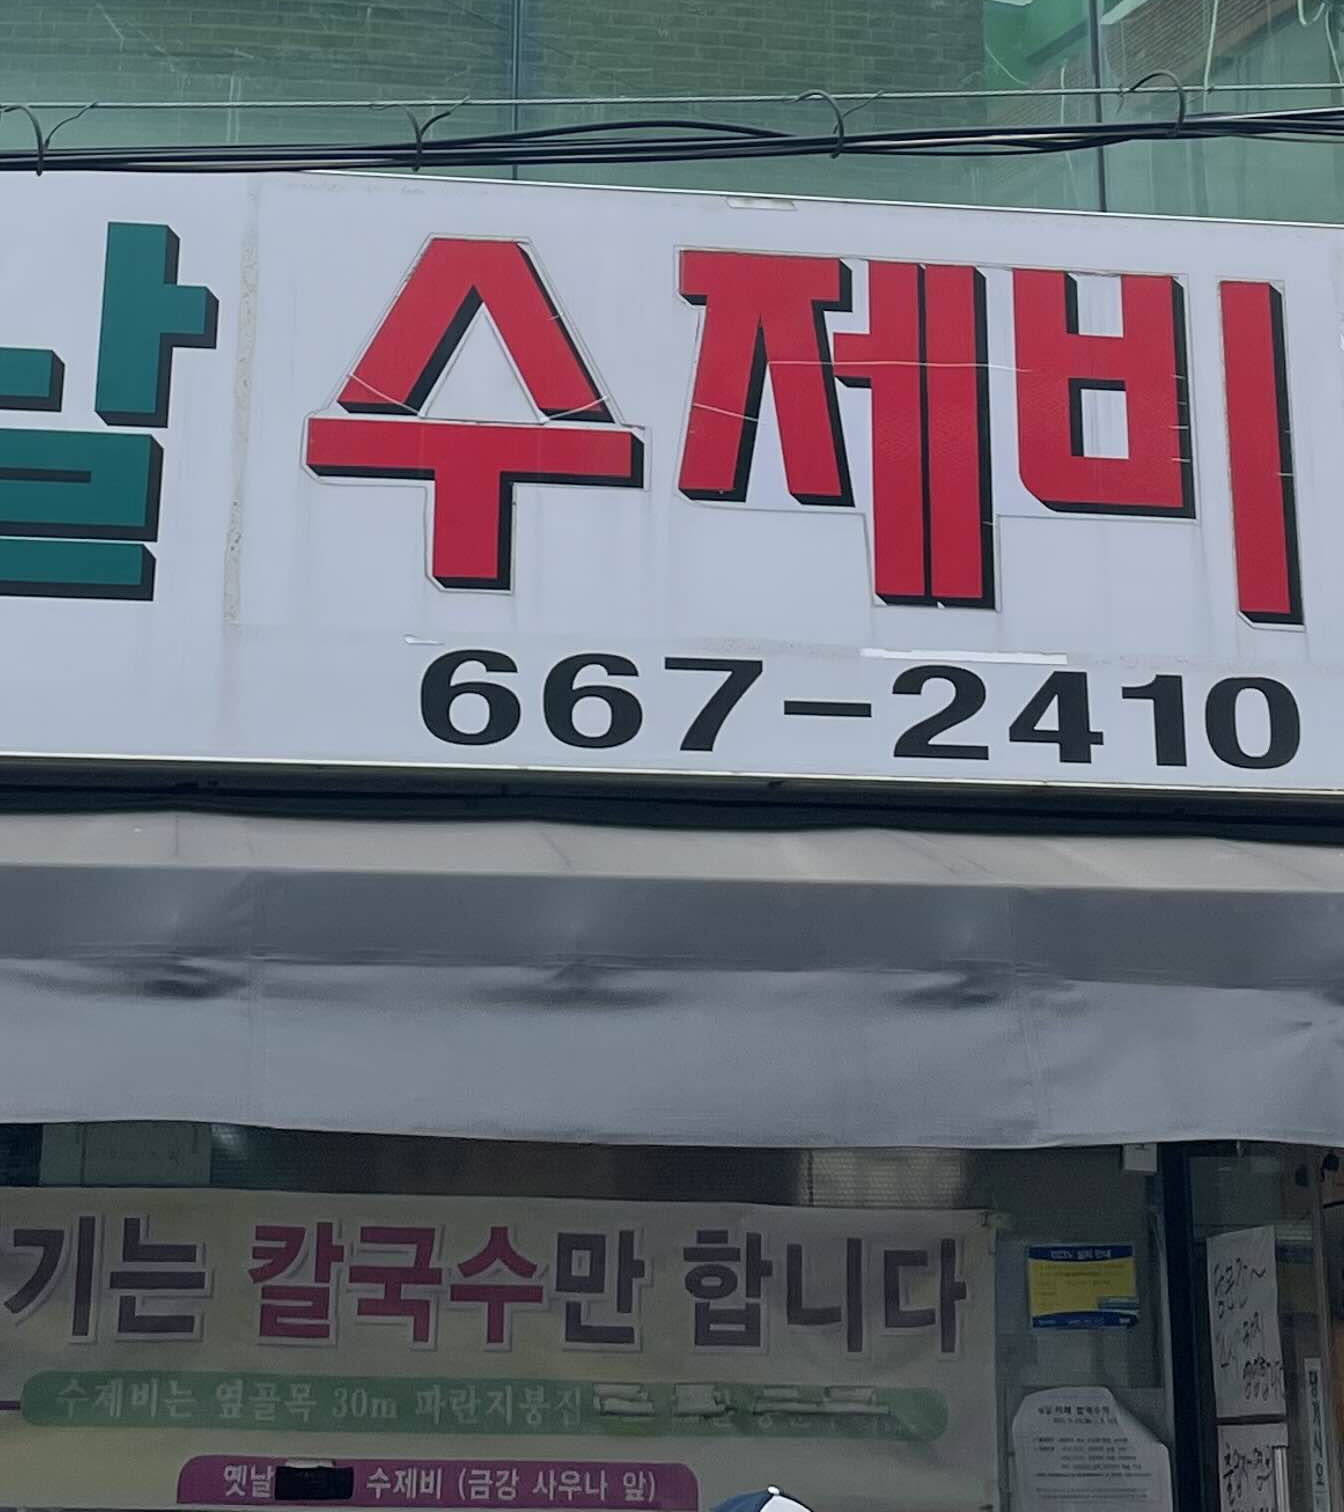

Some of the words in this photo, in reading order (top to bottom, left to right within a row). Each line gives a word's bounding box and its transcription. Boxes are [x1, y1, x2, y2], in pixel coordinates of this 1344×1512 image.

[306, 236, 1304, 626] 수제비
[418, 648, 1301, 770] 667-2410
[247, 1221, 647, 1345] 칼국수만
[682, 1229, 967, 1354] 합니다
[56, 1378, 196, 1420] 수제비는
[215, 1378, 318, 1423] 옆골목
[331, 1387, 398, 1420] 30m
[224, 1464, 274, 1499] 옛날
[366, 1470, 443, 1499] 수제비
[458, 1469, 519, 1502] (금강
[532, 1471, 608, 1502] 사우나
[622, 1471, 656, 1502] 앞)
